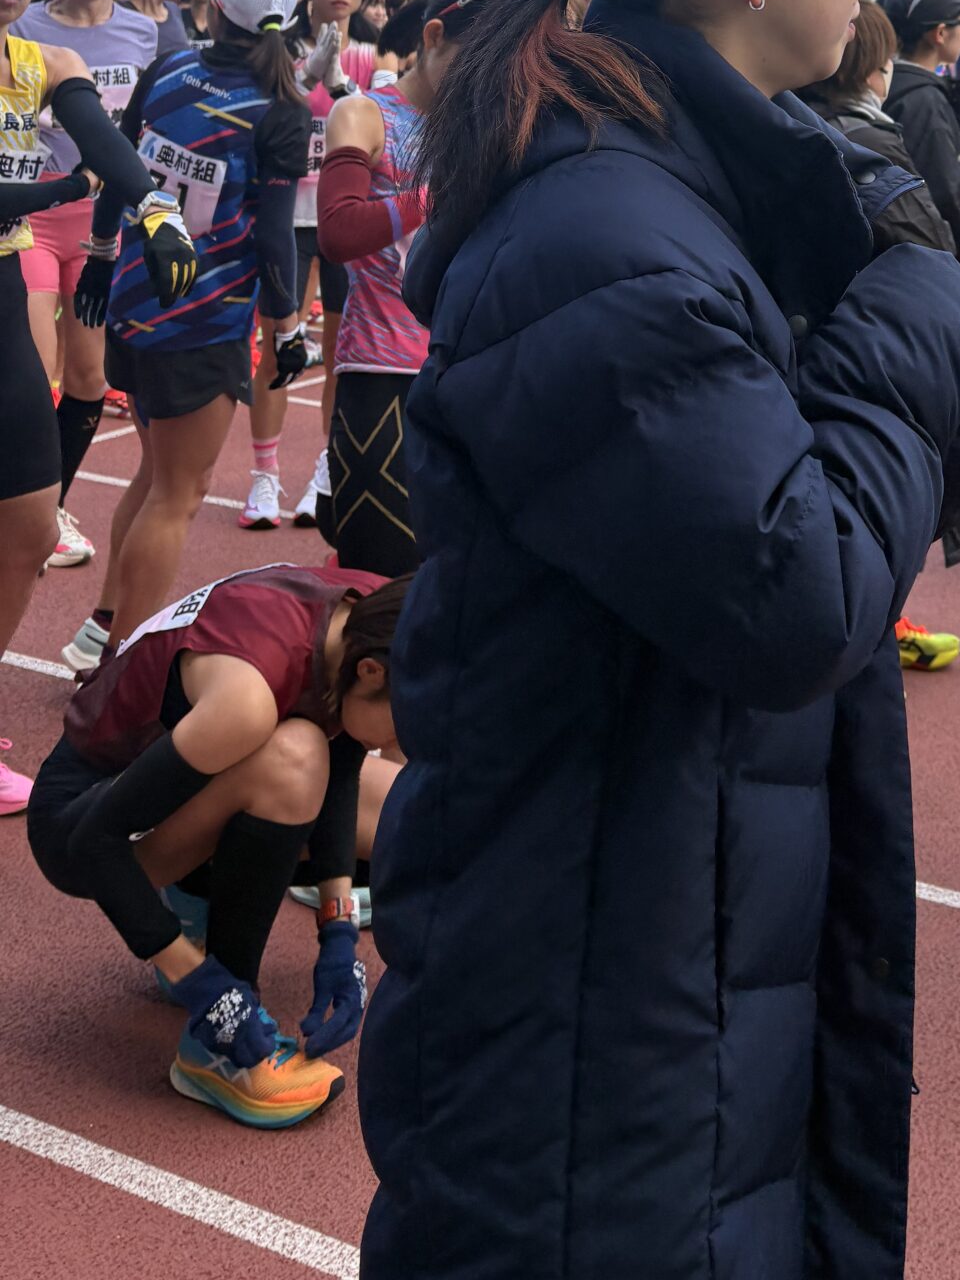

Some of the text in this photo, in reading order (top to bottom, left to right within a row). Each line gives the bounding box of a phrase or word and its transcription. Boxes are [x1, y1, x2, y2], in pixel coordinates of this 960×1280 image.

[182, 73, 232, 101] 10th Anniv.
[155, 144, 217, 184] 奥村組
